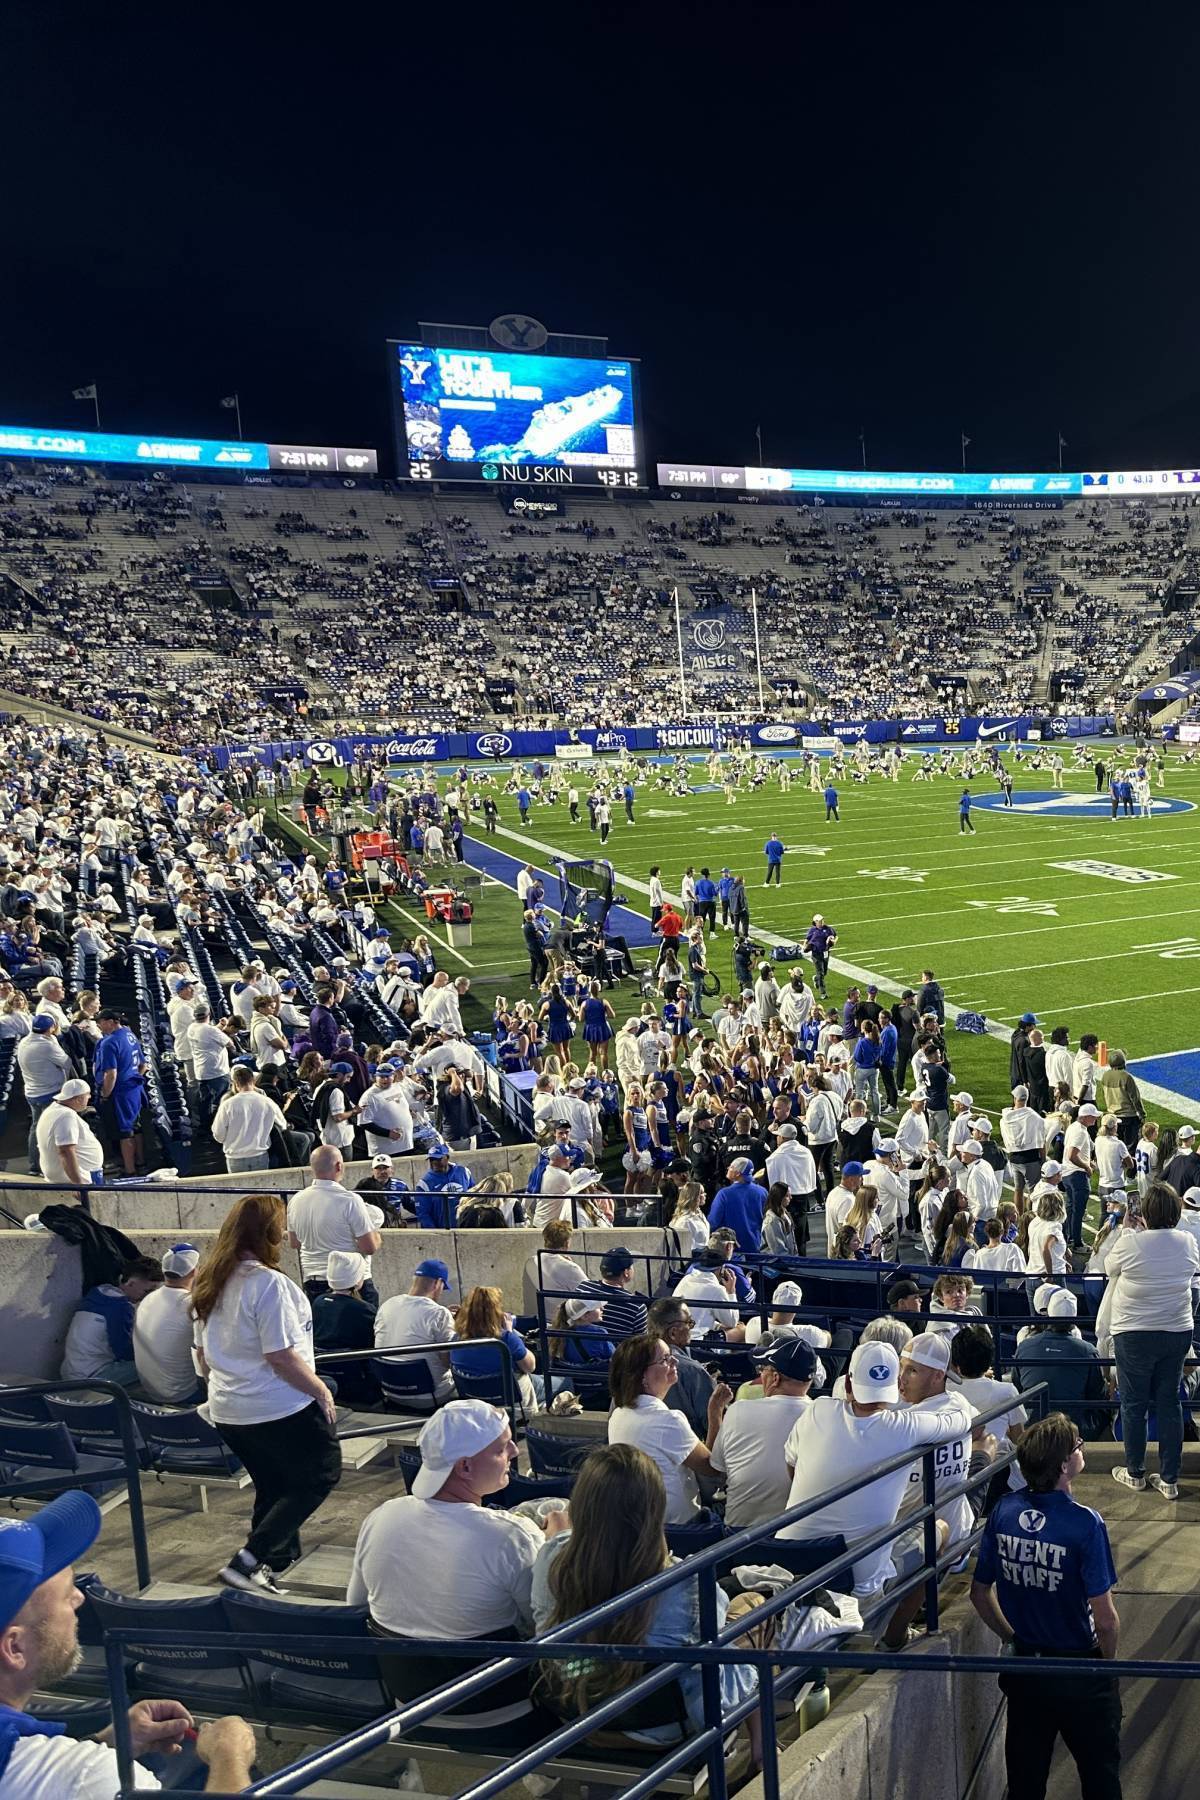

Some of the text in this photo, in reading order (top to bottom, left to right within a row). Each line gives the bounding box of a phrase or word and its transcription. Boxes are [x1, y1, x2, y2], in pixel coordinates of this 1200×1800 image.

[501, 318, 537, 347] Y
[307, 453, 329, 467] PM
[409, 462, 432, 479] 25
[502, 465, 573, 484] NU SKIN
[597, 471, 639, 487] 43:12
[690, 470, 707, 484] PM
[1117, 473, 1125, 485] 0
[1161, 472, 1168, 484] 0
[973, 501, 1057, 510] 1640 Riverside Drive
[766, 728, 790, 738] Ford
[945, 723, 959, 734] 25
[656, 728, 727, 747] #GOCOUS
[311, 744, 332, 759] Y
[387, 737, 438, 757] Coca-Cola
[922, 1069, 931, 1087] 3
[727, 1144, 752, 1152] POLICE
[935, 1440, 963, 1466] GO
[909, 1460, 971, 1483] CUGAR
[1021, 1512, 1044, 1531] Y
[996, 1533, 1067, 1569] EVENT
[1000, 1557, 1064, 1593] STAFF
